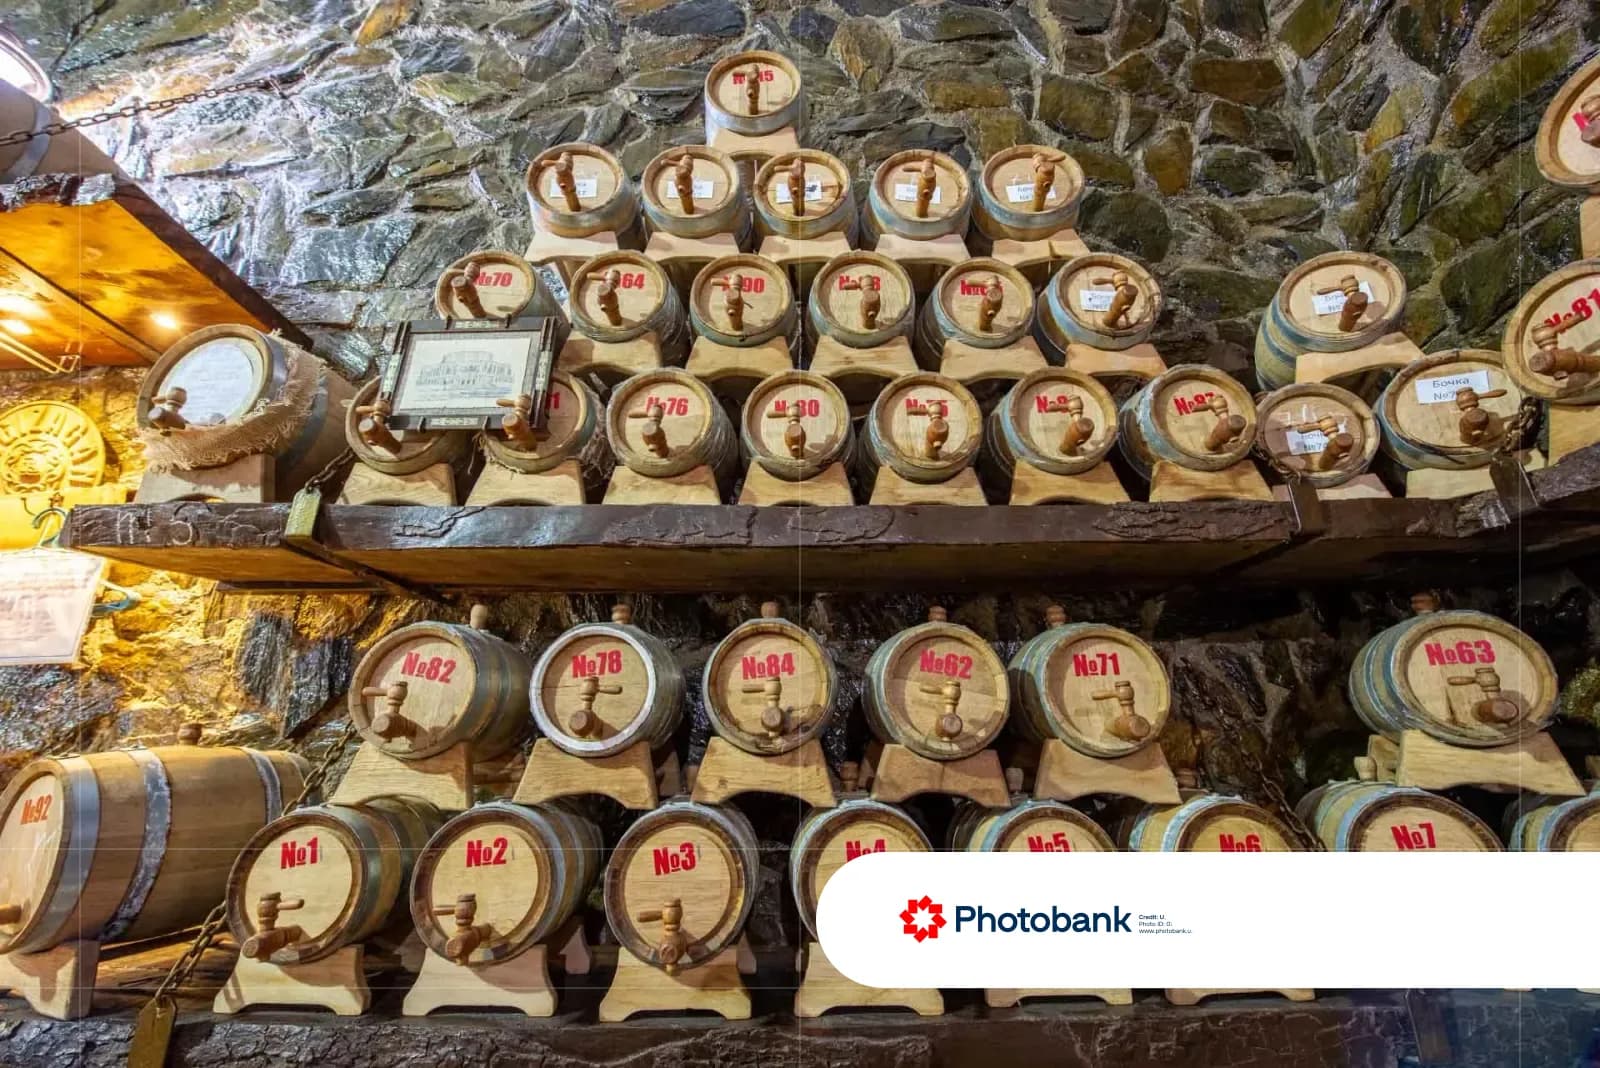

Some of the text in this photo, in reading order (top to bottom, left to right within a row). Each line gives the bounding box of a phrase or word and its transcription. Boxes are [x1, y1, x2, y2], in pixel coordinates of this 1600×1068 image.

[1432, 377, 1470, 388] Бочка
[1433, 391, 1456, 401] №7
[571, 649, 622, 679] №78
[741, 651, 795, 681] №84
[919, 648, 973, 679] №62
[1071, 651, 1121, 677] №71
[1425, 639, 1496, 666] №63
[401, 652, 457, 684] №82
[20, 794, 52, 825] №92
[1391, 821, 1437, 850] №7
[280, 837, 320, 870] №1
[466, 837, 508, 867] №2
[653, 842, 697, 876] №3
